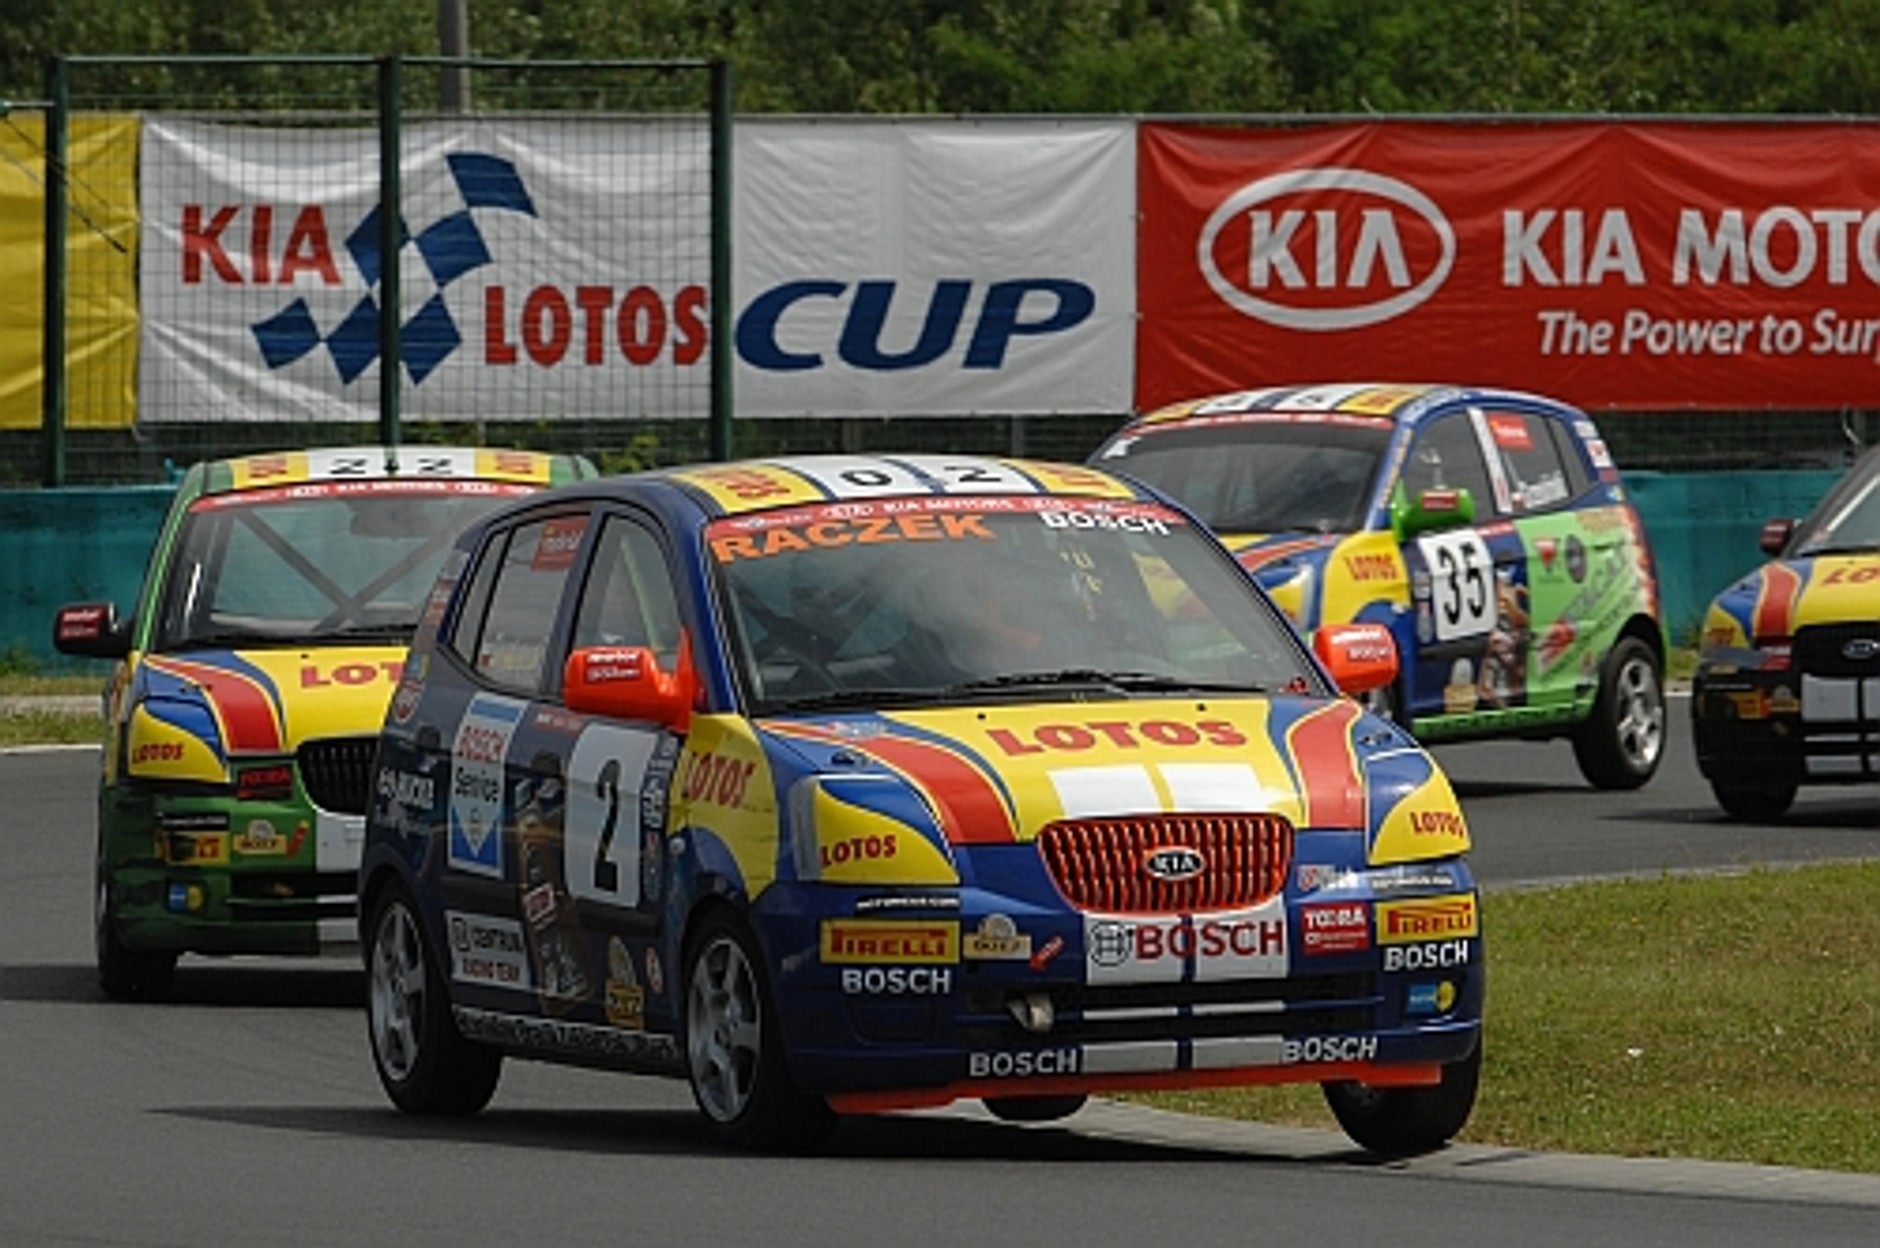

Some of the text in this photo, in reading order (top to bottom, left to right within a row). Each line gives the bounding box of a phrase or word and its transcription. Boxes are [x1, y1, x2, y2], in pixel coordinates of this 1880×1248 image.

[182, 204, 343, 285] KIA
[1247, 210, 1411, 288] KIA
[1503, 208, 1645, 287] KIA
[485, 283, 708, 367] LOTOS
[735, 278, 1096, 371] CUP
[1537, 307, 1880, 366] The Power to Sur
[943, 465, 1002, 482] 2
[710, 513, 996, 564] RACZEK
[1040, 510, 1171, 536] BOSCH
[1436, 541, 1488, 626] 35
[132, 742, 184, 764] LOTOS
[985, 719, 1249, 757] LOTOS
[683, 752, 756, 810] LOTOS
[594, 758, 622, 893] 2
[820, 834, 897, 868] LOTOS
[1154, 856, 1197, 874] KIA
[1386, 902, 1472, 936] PIRELLI
[830, 927, 948, 956] PIRELLI
[1135, 920, 1285, 961] BOSCH
[1383, 940, 1469, 972] BOSCH
[842, 968, 951, 994] BOSCH
[969, 1051, 1078, 1077] BOSCH
[1284, 1036, 1379, 1064] BOSCH
